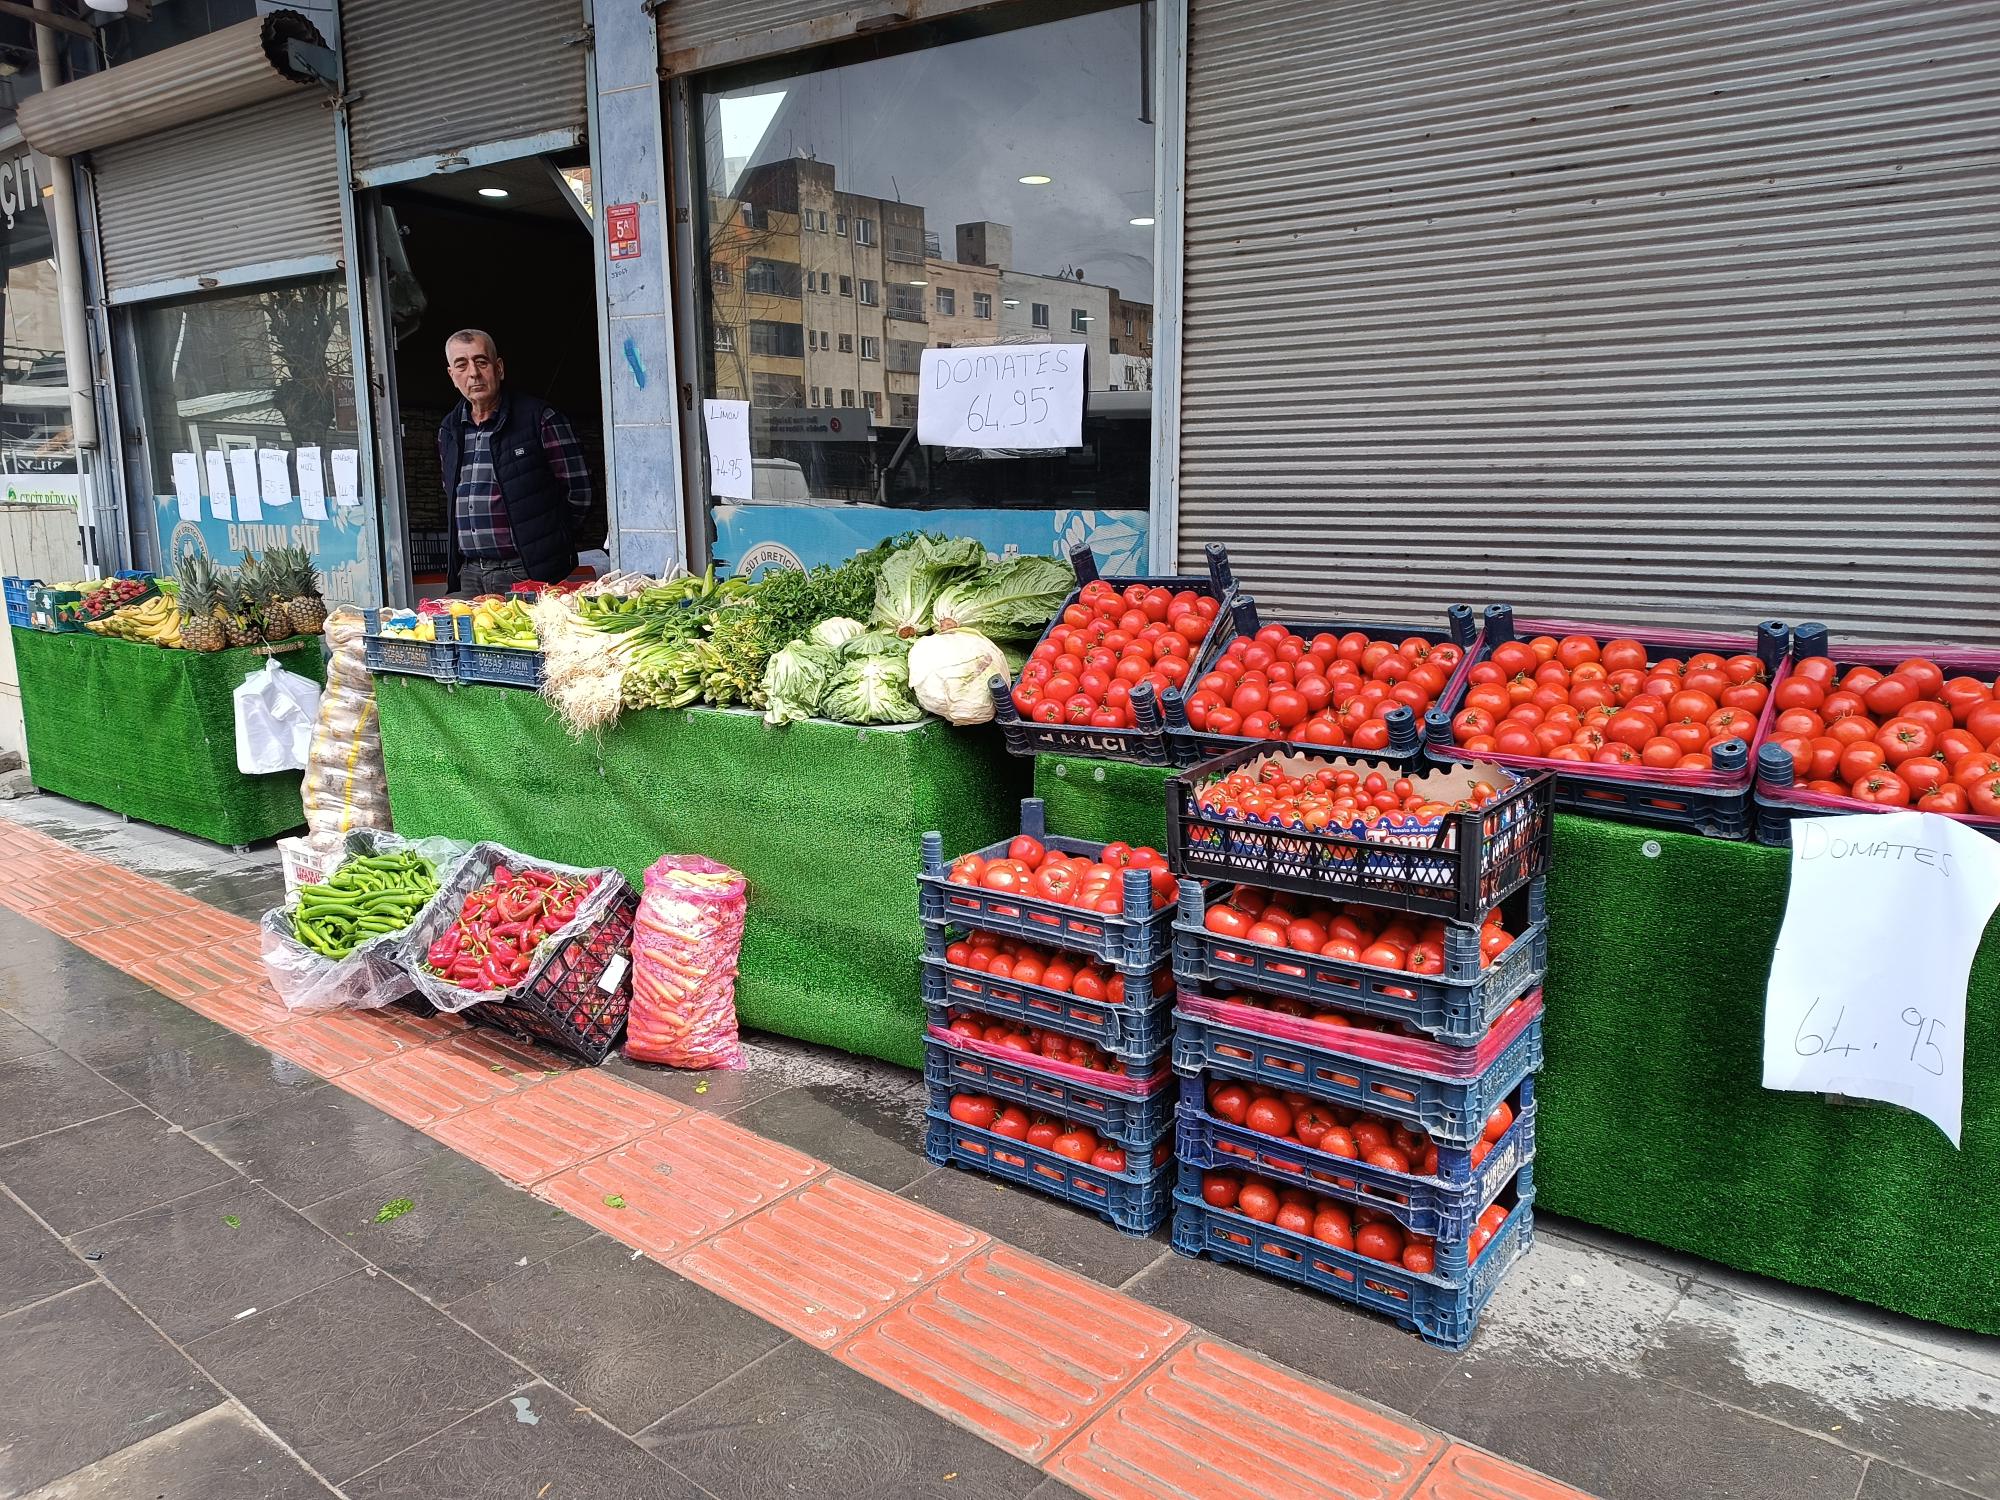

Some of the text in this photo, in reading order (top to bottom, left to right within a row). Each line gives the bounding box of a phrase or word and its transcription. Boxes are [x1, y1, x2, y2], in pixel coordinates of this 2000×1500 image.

[0, 154, 38, 230] ÇİT
[936, 350, 1069, 389] DOMATES
[967, 387, 1049, 432] 64.95
[228, 519, 320, 556] BATMAN SÜT
[746, 556, 759, 576] SÜT
[1801, 821, 1952, 877] DOMATES
